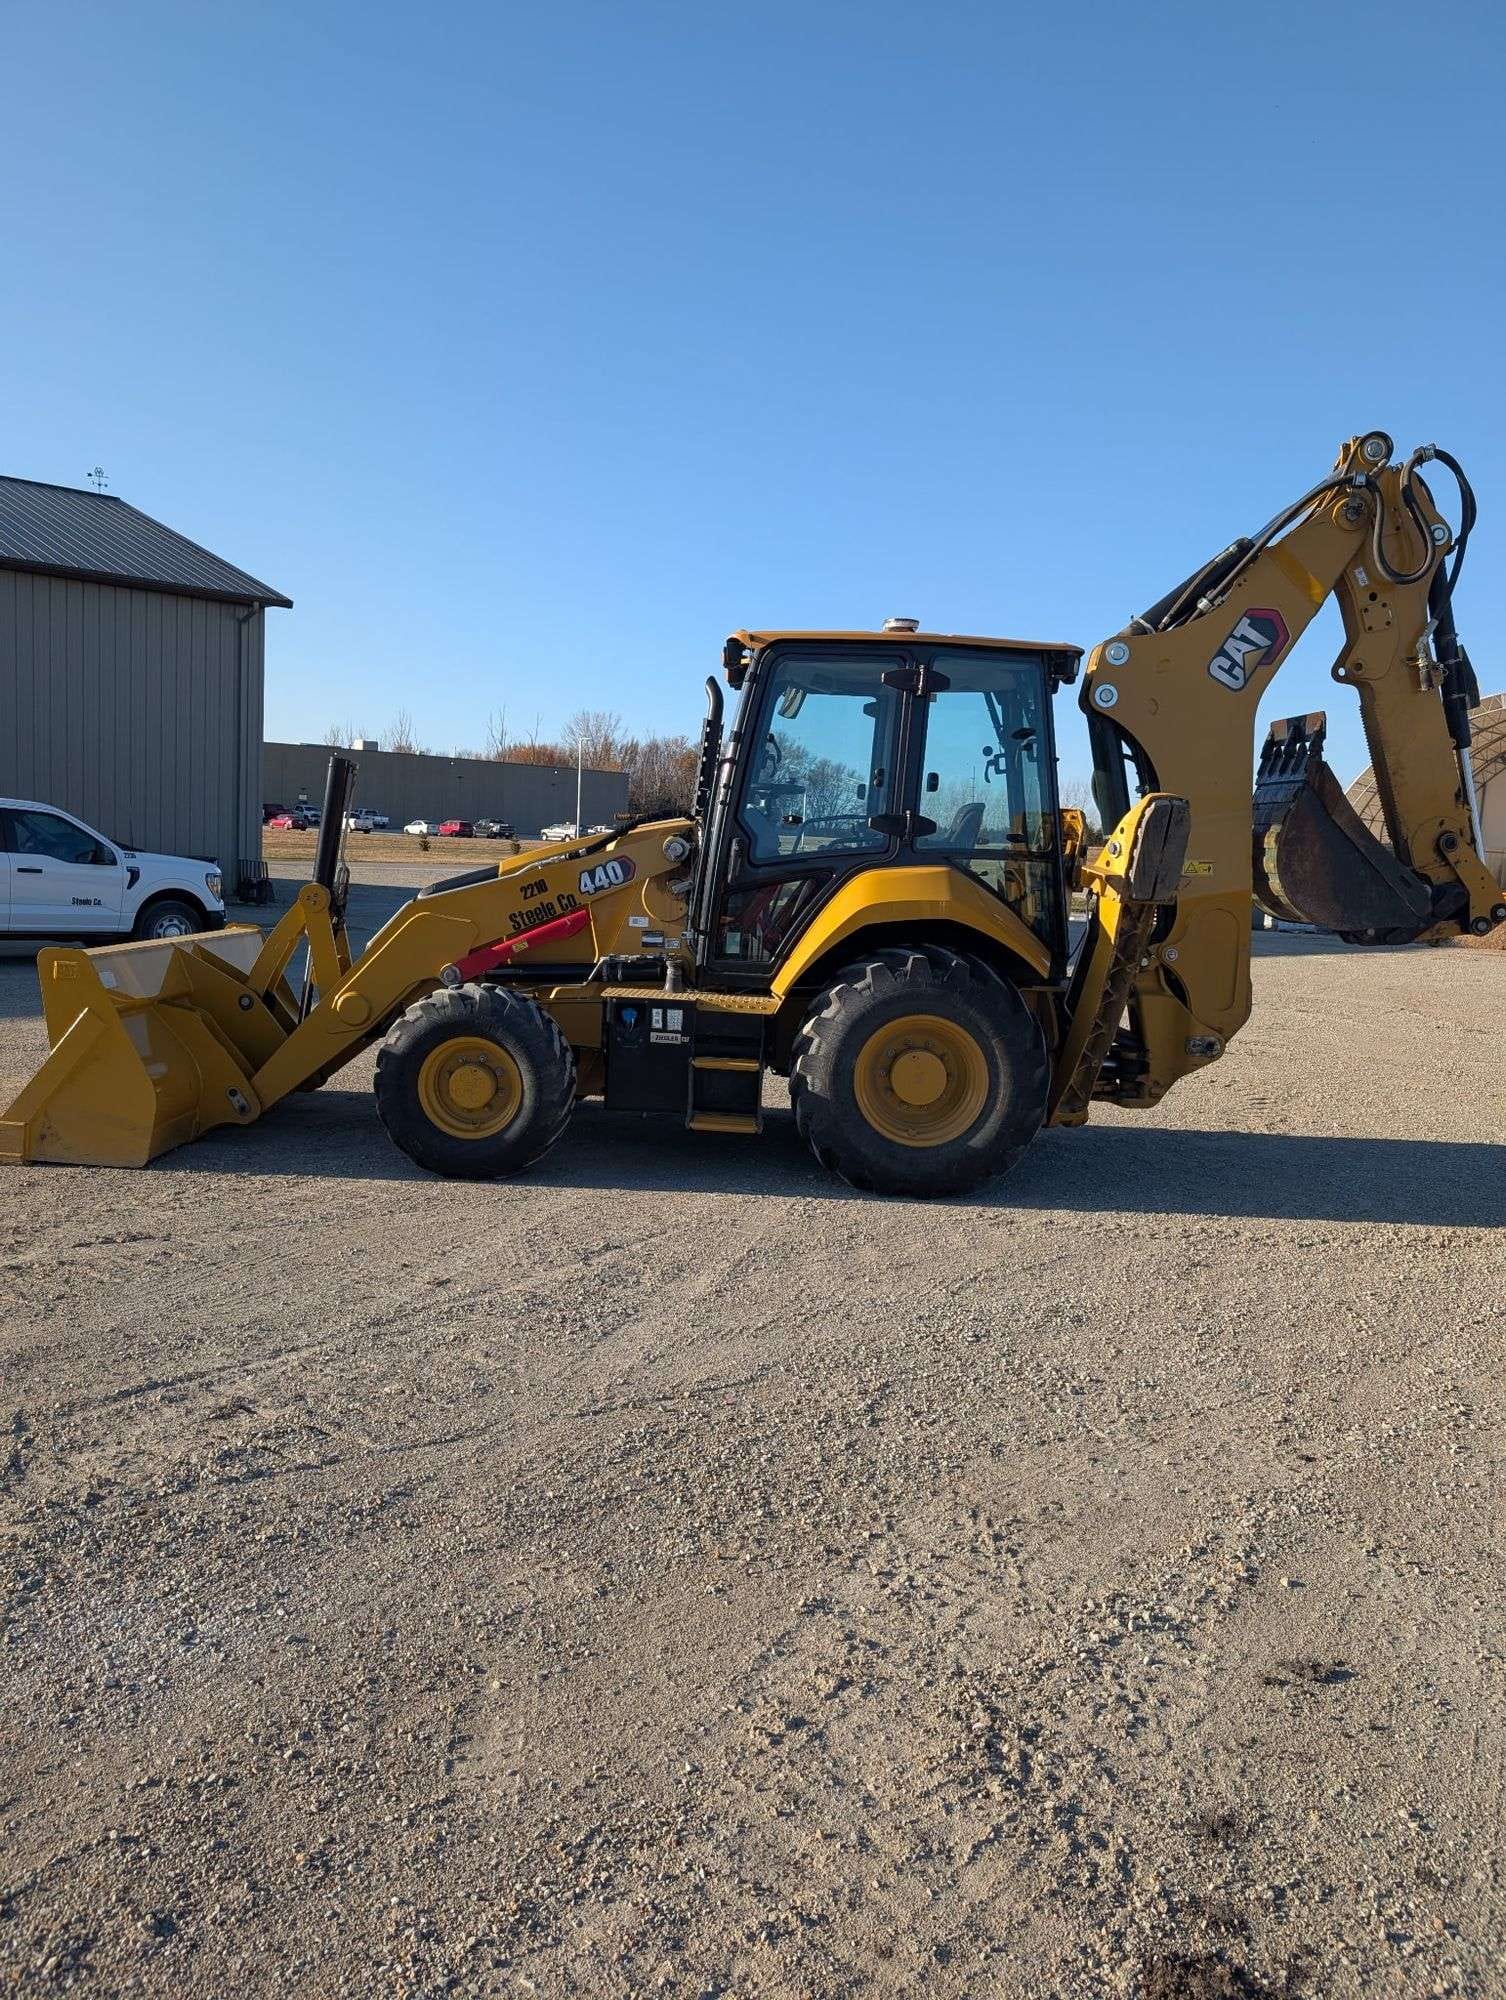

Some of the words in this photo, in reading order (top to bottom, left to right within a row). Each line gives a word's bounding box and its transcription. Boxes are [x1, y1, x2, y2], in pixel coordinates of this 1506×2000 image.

[1209, 616, 1273, 690] CAT
[580, 861, 624, 895] 440
[508, 902, 558, 931] Steele
[556, 893, 582, 912] Co.
